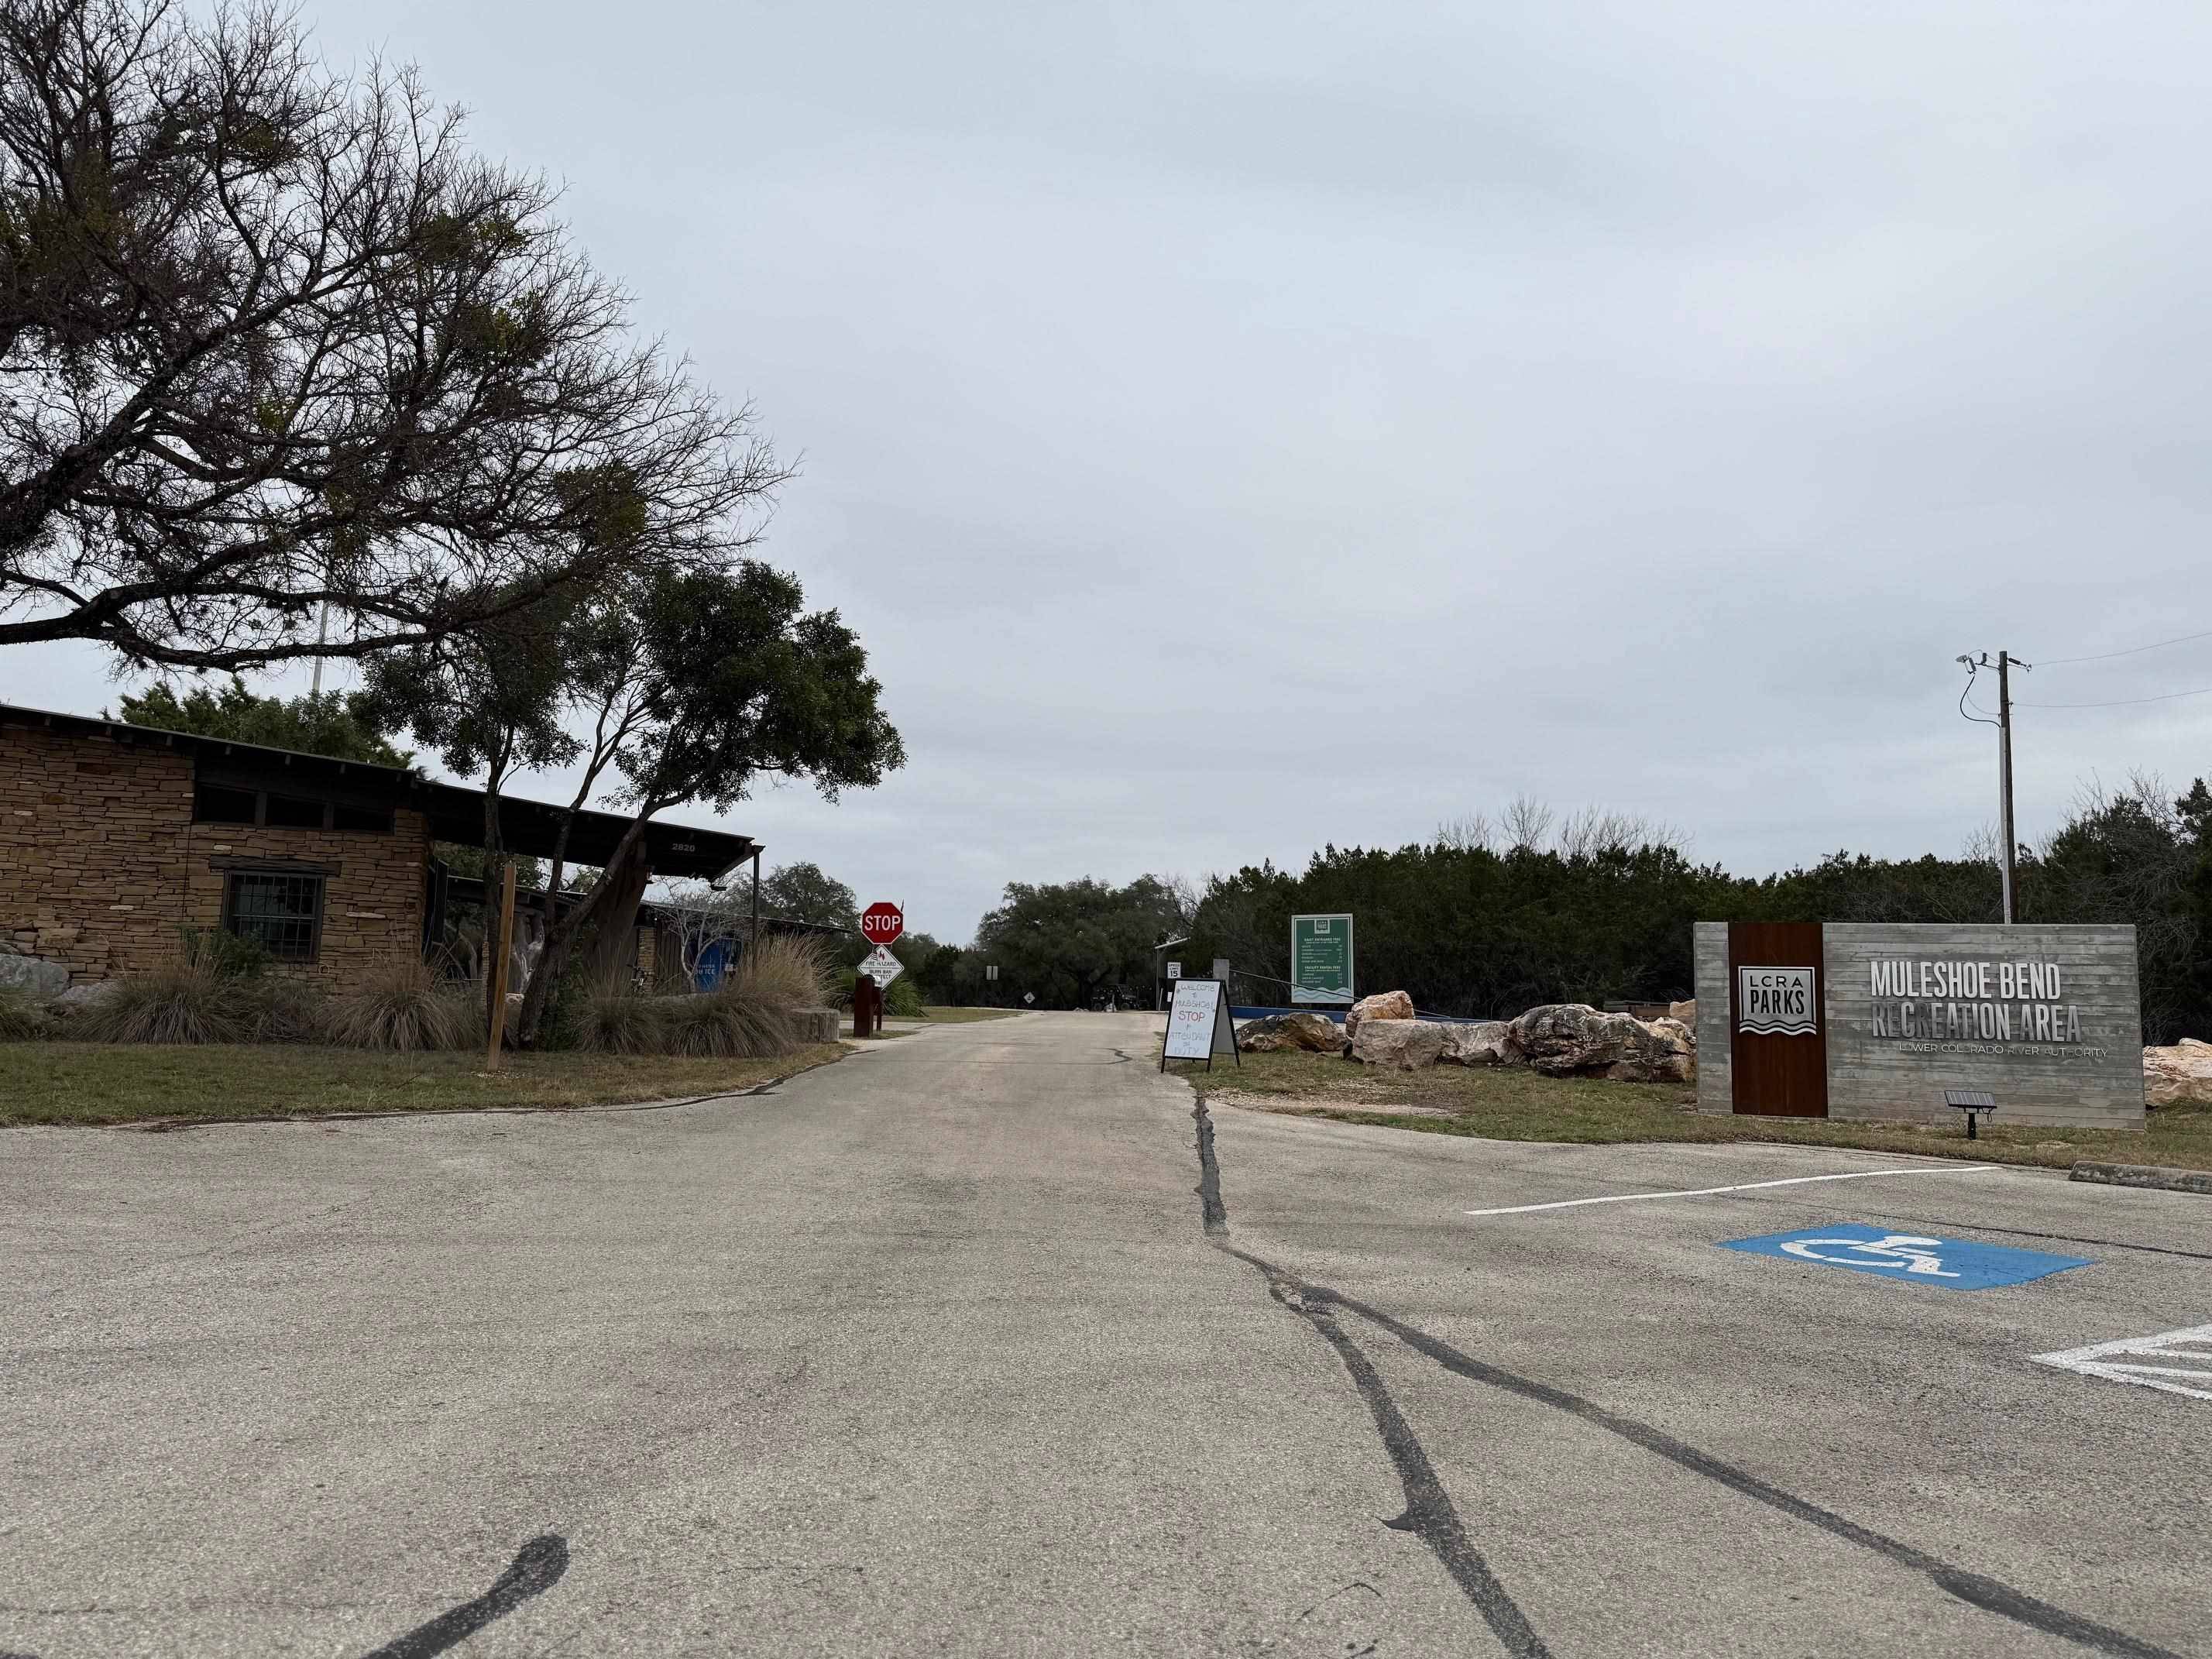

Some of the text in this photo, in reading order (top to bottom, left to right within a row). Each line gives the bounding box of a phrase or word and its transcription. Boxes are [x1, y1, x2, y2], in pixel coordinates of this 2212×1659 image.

[672, 843, 695, 852] 2820
[864, 915, 901, 931] STOP
[1750, 975, 1803, 988] LCRA
[1870, 960, 2061, 1000] MULESHOE BEND
[1750, 989, 1805, 1015] PARKS
[1178, 1010, 1206, 1022] STOP
[1871, 1001, 2082, 1042] RECREATION AREA
[1899, 1042, 1938, 1053] LOWER
